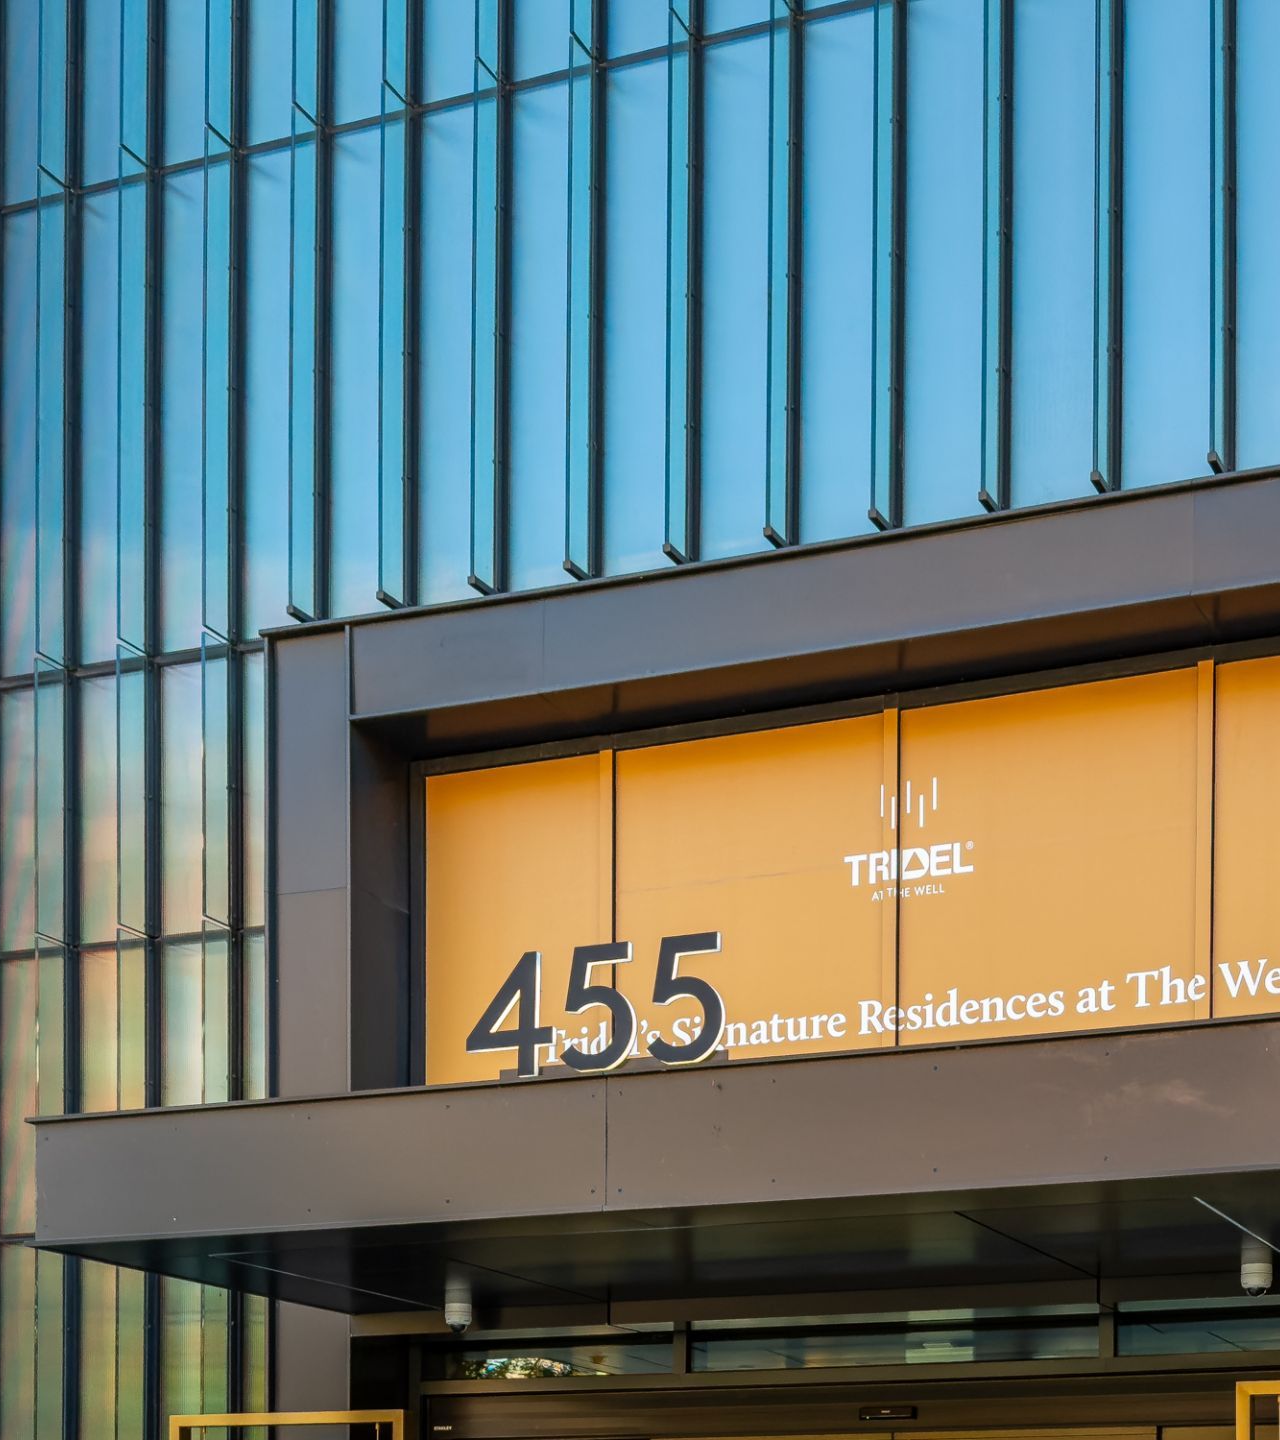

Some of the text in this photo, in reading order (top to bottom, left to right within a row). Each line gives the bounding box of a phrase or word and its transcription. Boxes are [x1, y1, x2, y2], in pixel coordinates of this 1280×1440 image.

[871, 883, 945, 902] AT THE WELL
[466, 930, 726, 1077] 455
[671, 1011, 847, 1051] Sinature
[858, 987, 1066, 1036] Residences
[1075, 979, 1117, 1015] at
[1125, 964, 1207, 1008] The
